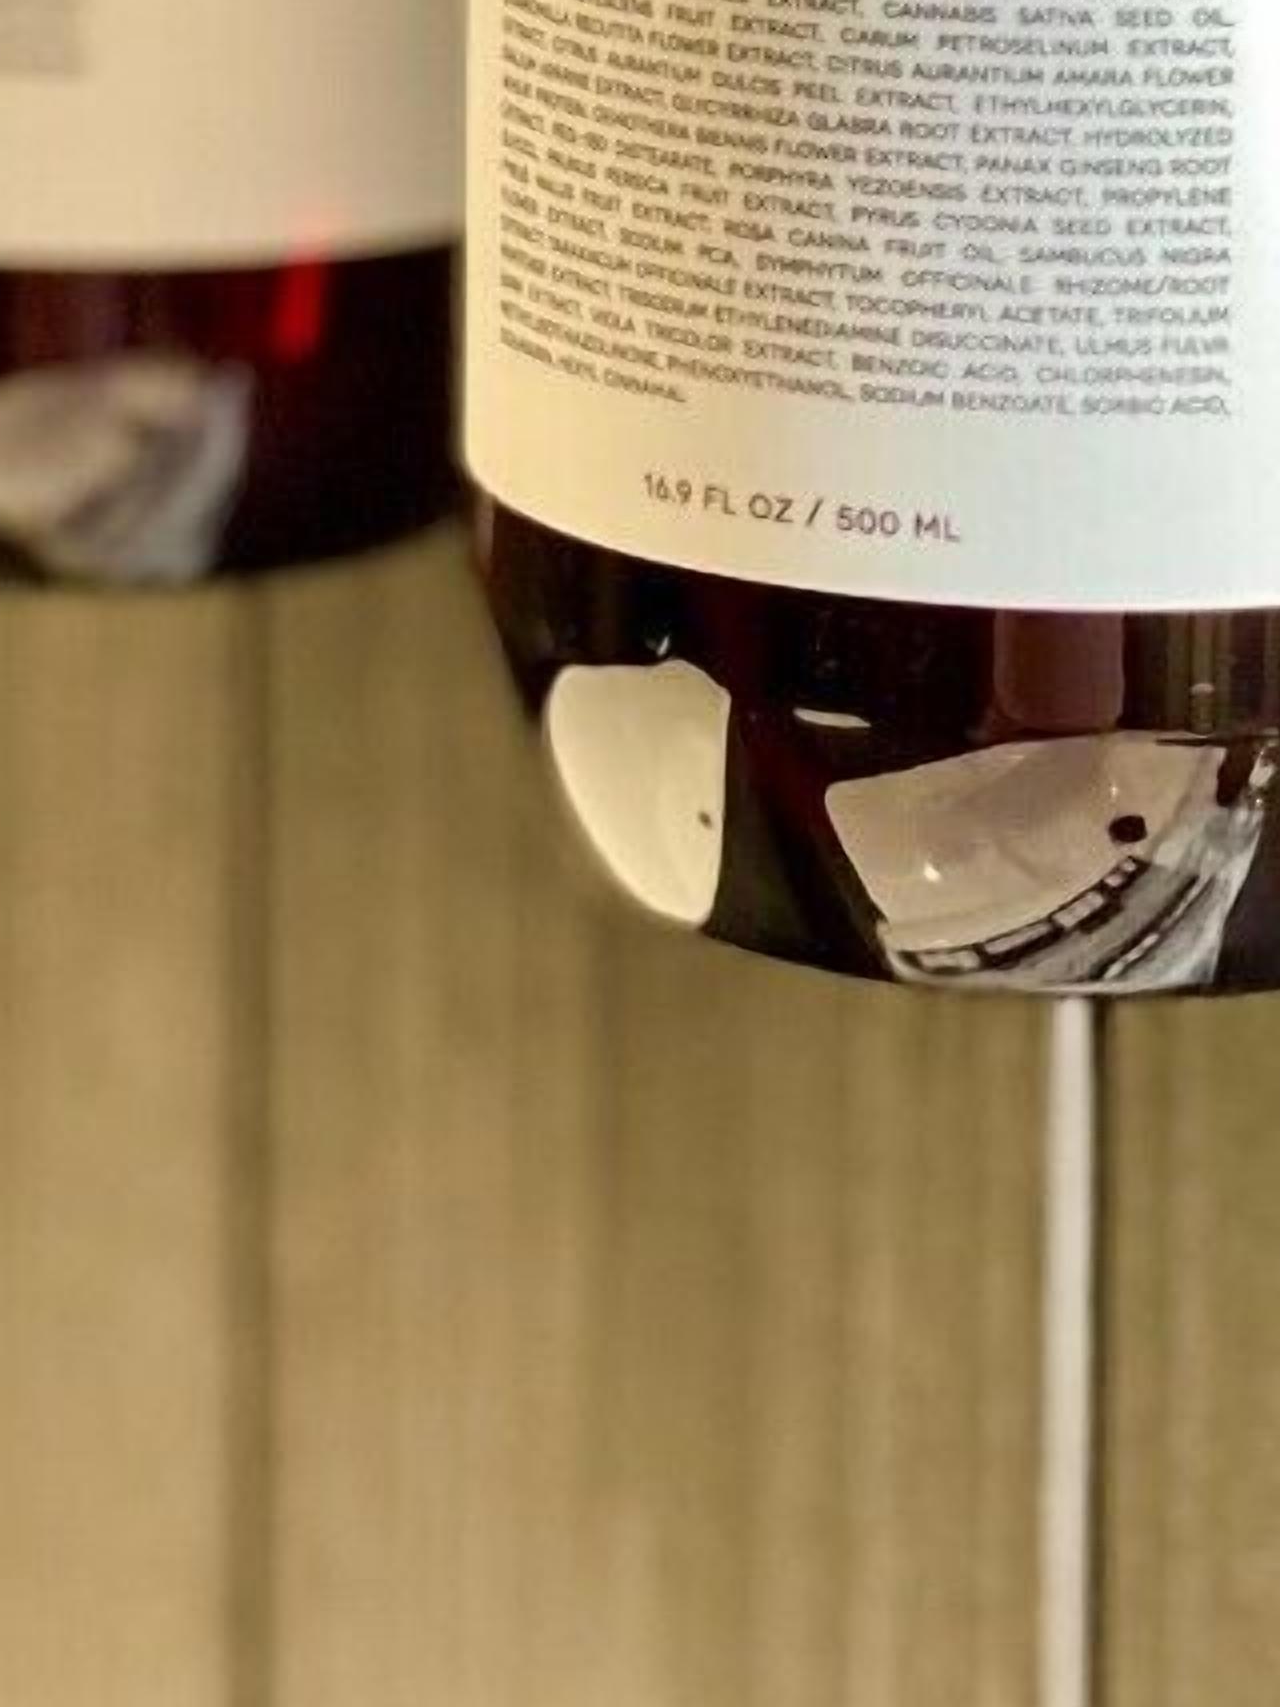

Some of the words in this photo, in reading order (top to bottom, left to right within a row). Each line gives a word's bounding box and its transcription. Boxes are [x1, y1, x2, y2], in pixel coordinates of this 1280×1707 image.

[644, 473, 692, 505] 16.9
[703, 485, 737, 516] FL
[749, 493, 794, 524] OZ
[805, 498, 824, 528] /
[836, 505, 900, 537] 500
[914, 511, 962, 543] ML
